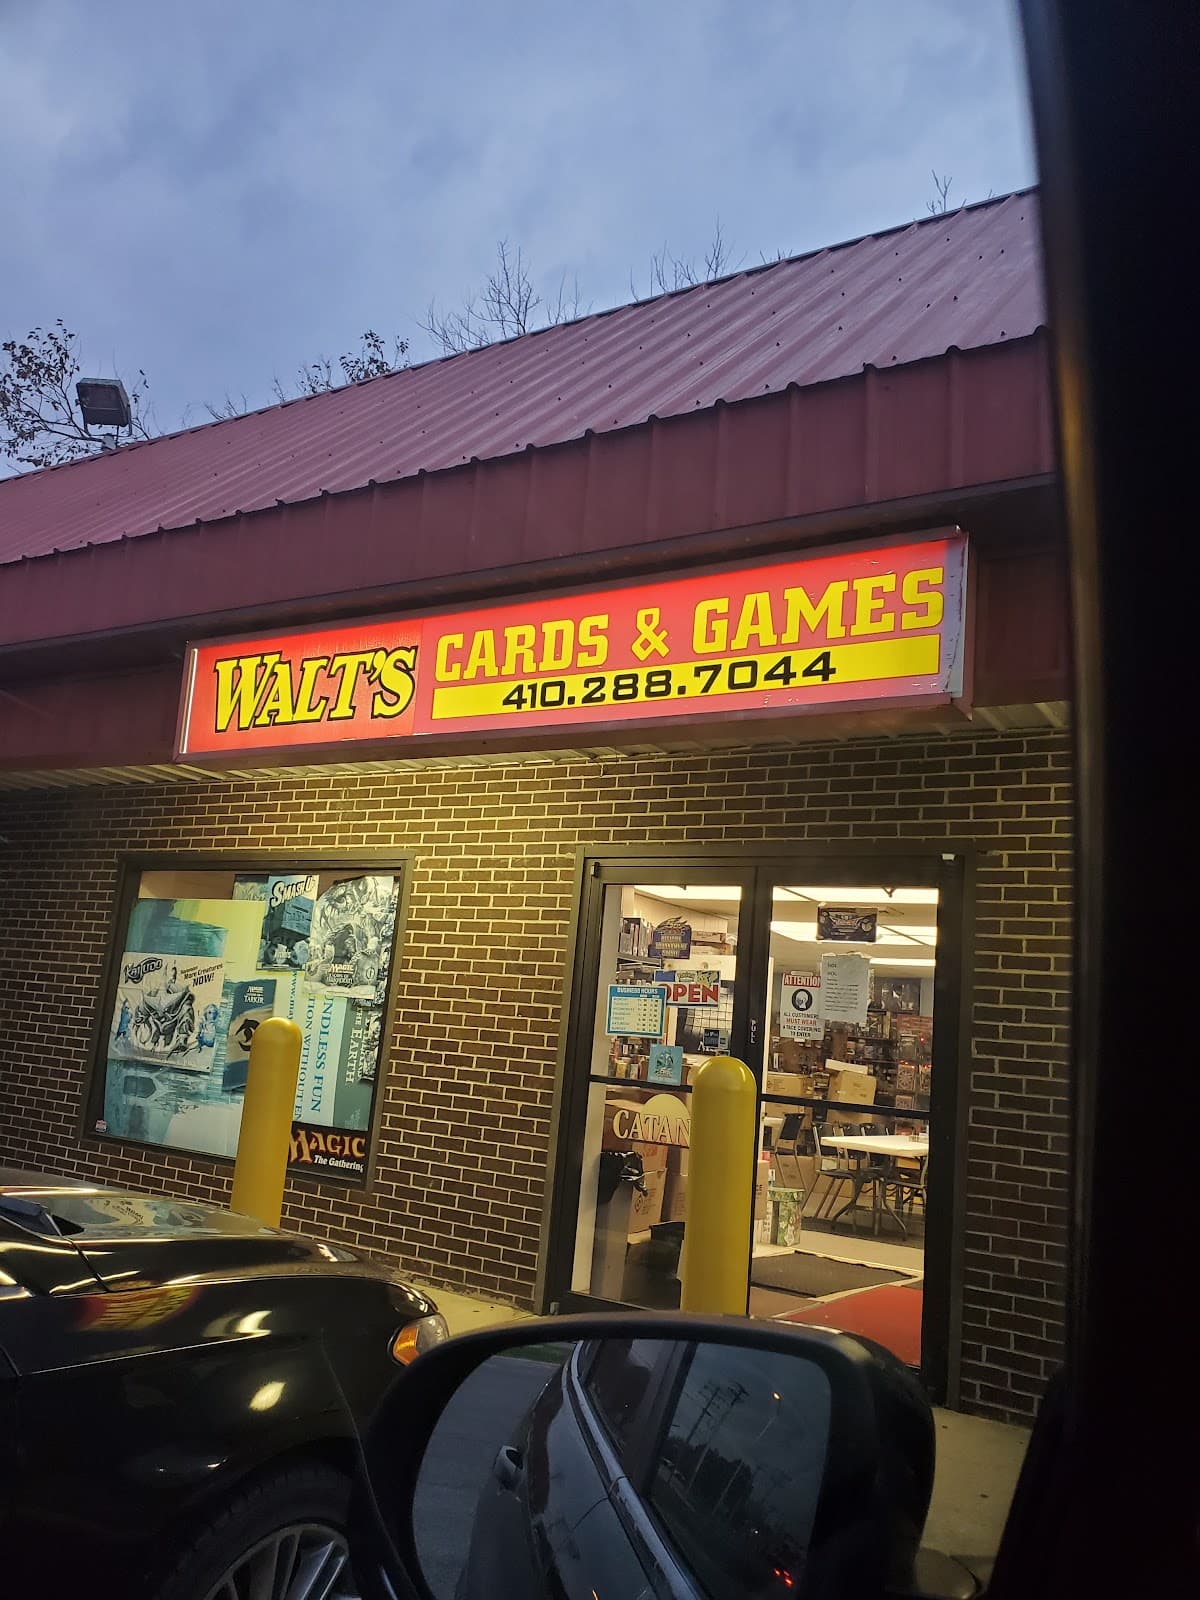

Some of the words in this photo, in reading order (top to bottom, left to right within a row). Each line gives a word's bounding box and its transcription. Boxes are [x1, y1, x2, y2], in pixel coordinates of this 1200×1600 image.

[434, 614, 609, 683] CARDS
[632, 607, 670, 661] &
[692, 566, 944, 652] GAMES
[213, 645, 418, 733] WALT'S
[502, 650, 837, 711] 410.288.7044
[192, 972, 215, 987] NOW!
[658, 983, 719, 1003] OPEN
[304, 993, 316, 1030] TION
[297, 1033, 312, 1099] WITHOUT
[345, 1027, 363, 1084] EARTH
[310, 1075, 324, 1113] FUN
[612, 1108, 692, 1147] CATAN
[289, 1129, 366, 1165] MAGIC
[314, 1154, 328, 1165] The
